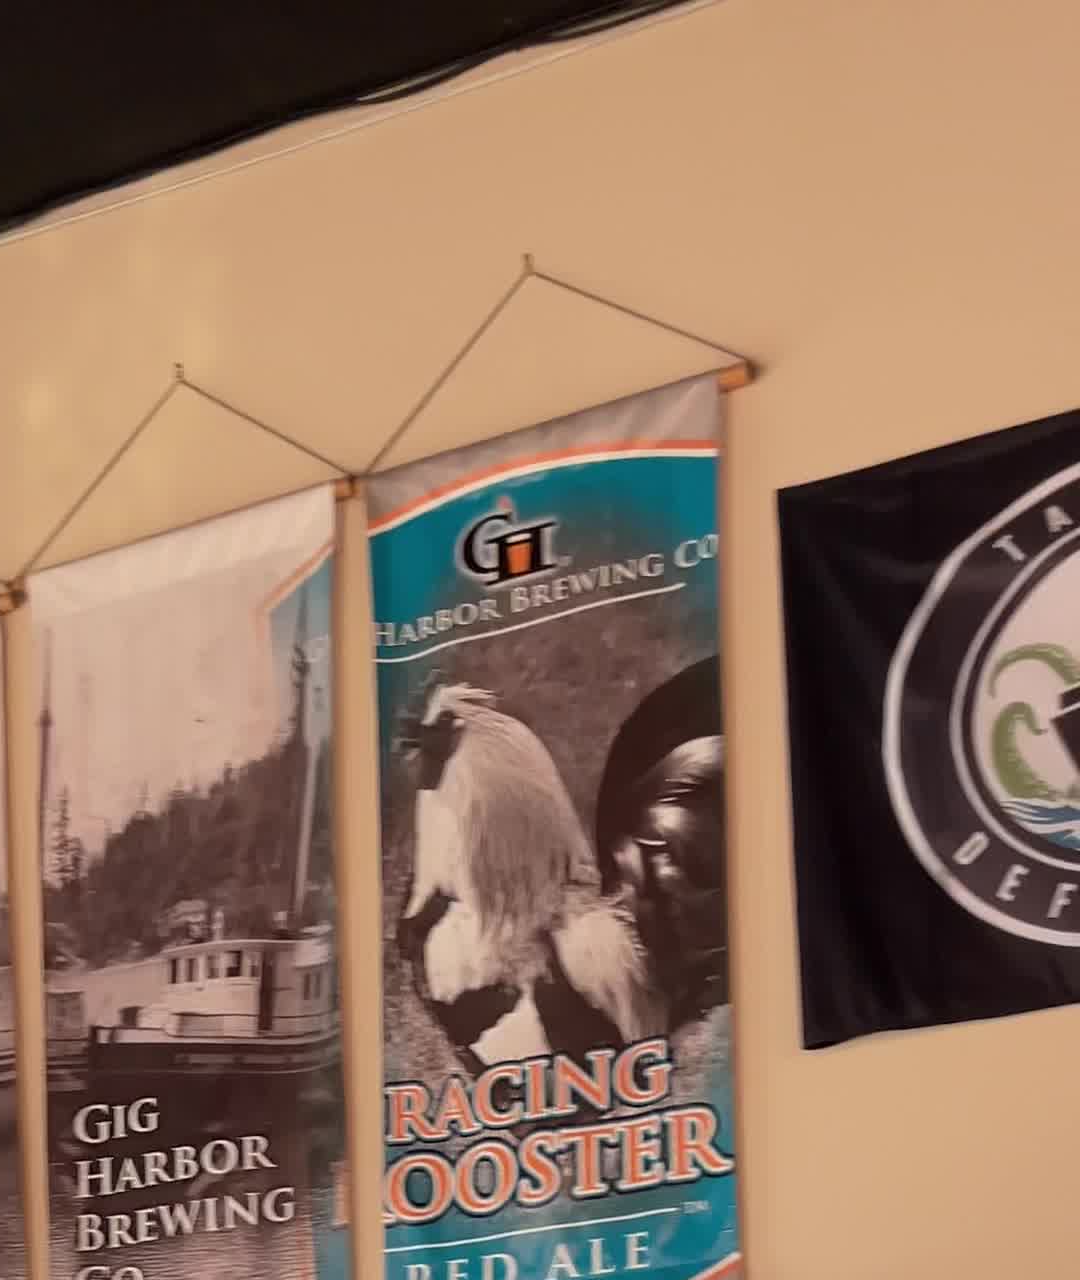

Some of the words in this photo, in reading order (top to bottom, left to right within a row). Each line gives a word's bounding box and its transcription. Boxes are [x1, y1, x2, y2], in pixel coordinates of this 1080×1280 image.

[373, 597, 505, 648] HARBOR
[509, 552, 665, 614] BREWING
[72, 1096, 161, 1145] GIG
[384, 1037, 674, 1144] RACING
[72, 1134, 279, 1199] HARBOR
[75, 1186, 296, 1252] BREWING
